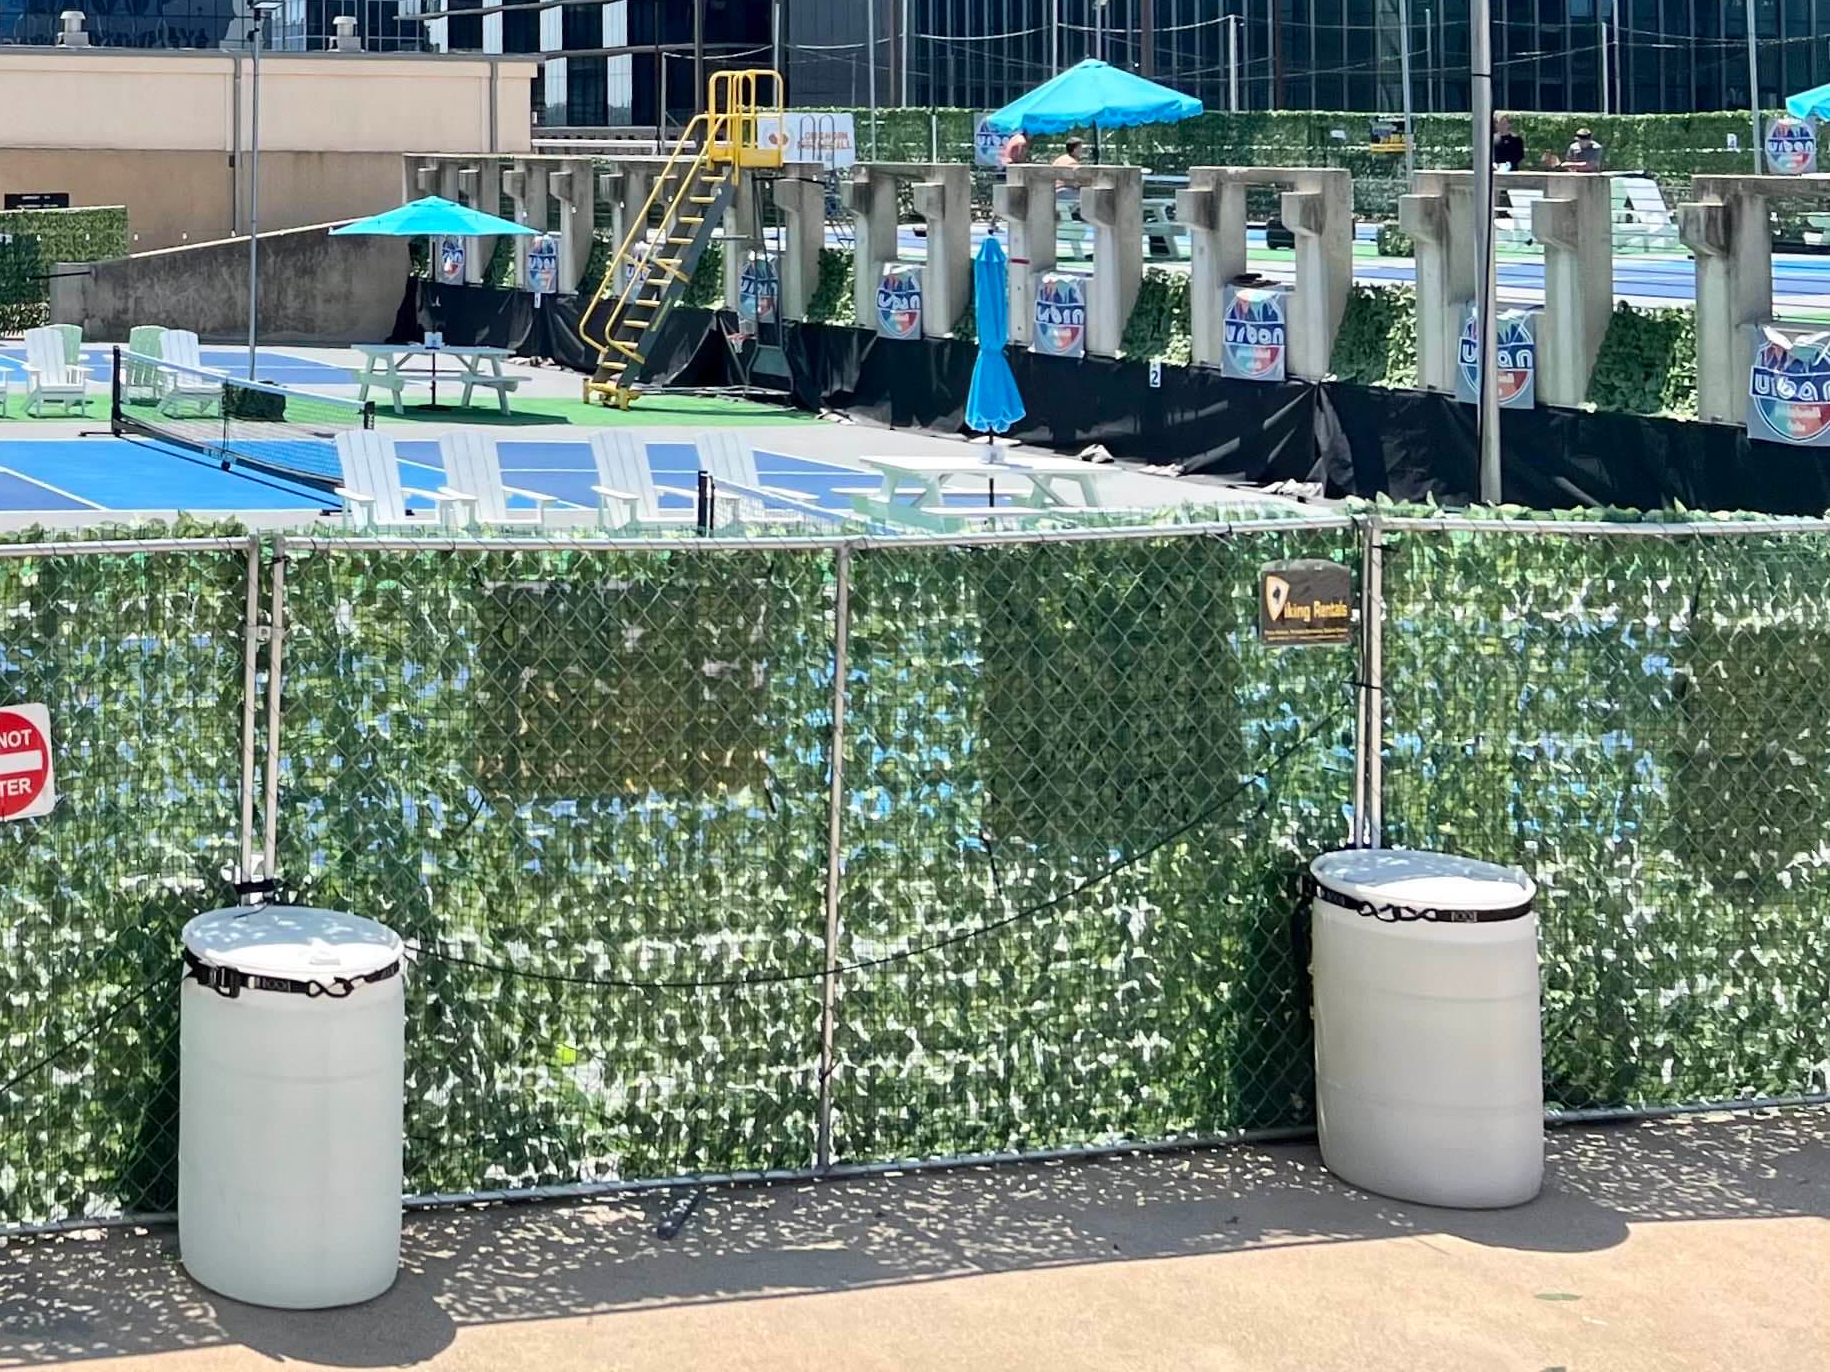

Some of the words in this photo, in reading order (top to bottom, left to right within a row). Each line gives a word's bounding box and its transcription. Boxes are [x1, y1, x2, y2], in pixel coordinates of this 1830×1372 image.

[1225, 324, 1285, 344] urban
[1151, 370, 1159, 386] 2
[1313, 600, 1348, 618] Rentals
